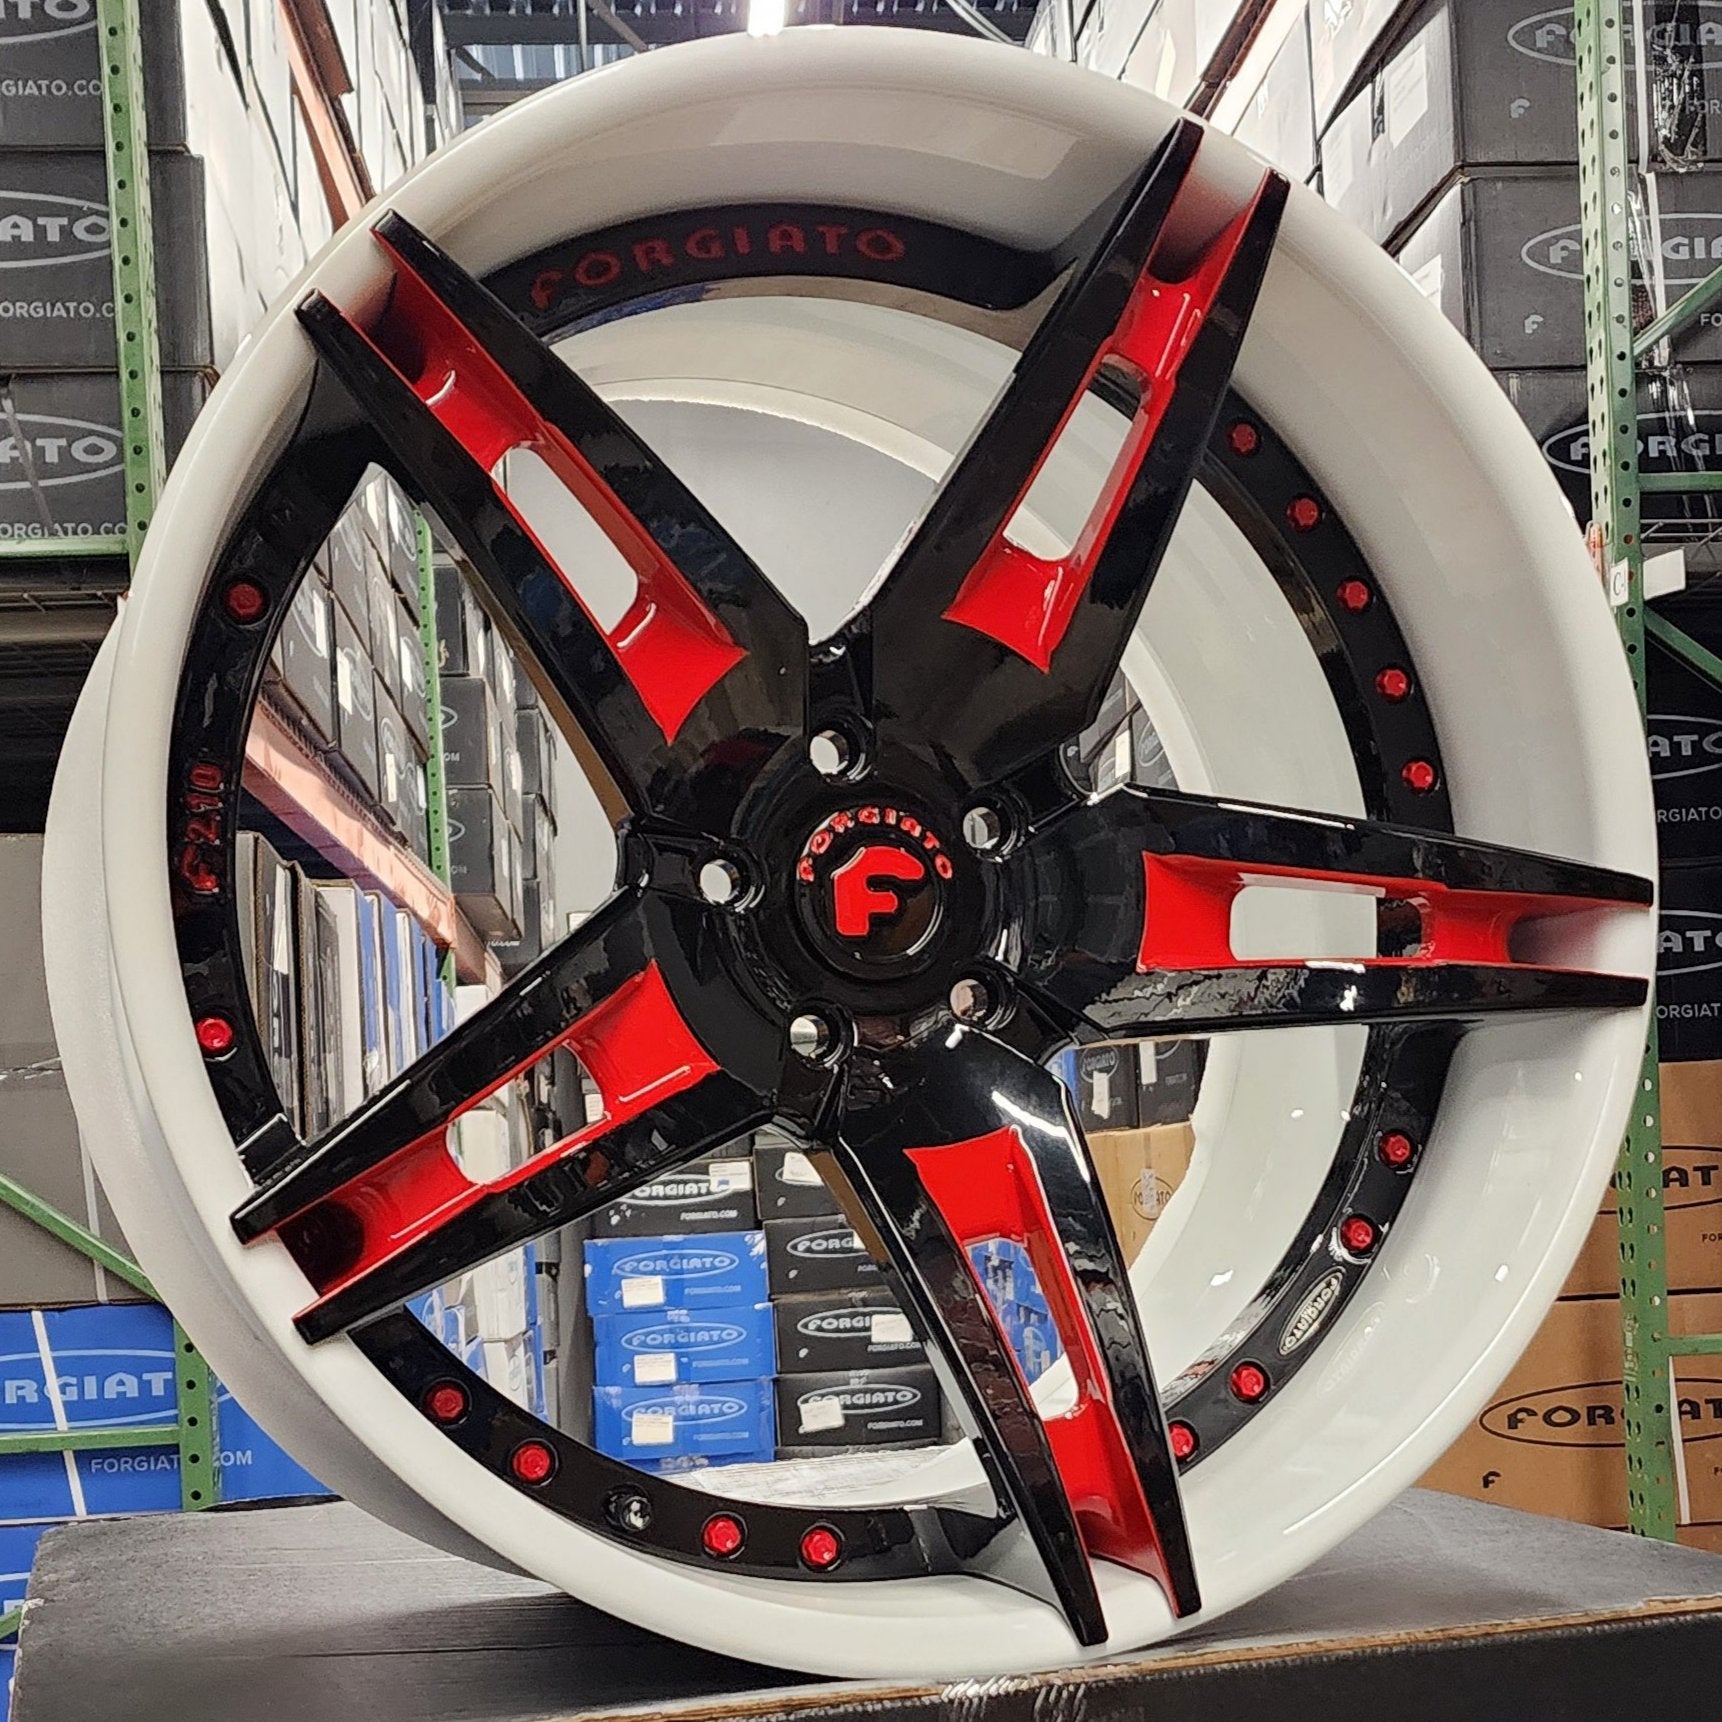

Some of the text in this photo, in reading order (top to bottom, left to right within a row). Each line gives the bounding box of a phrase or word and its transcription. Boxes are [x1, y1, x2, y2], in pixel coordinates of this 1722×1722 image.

[1, 79, 102, 96] GIATO.CO
[1510, 98, 1530, 118] F
[531, 220, 907, 310] FORGIATO
[0, 301, 114, 318] ORGIATO.C
[1524, 314, 1544, 334] F
[796, 806, 953, 883] FORGIATO
[831, 845, 925, 936] F
[1657, 929, 1722, 953] AT
[632, 1182, 710, 1198] ORGIAT
[622, 1256, 731, 1272] FORGIATO
[631, 1328, 739, 1346] FORGIATO
[4, 1372, 173, 1404] RGIAT
[1482, 1470, 1502, 1489] F
